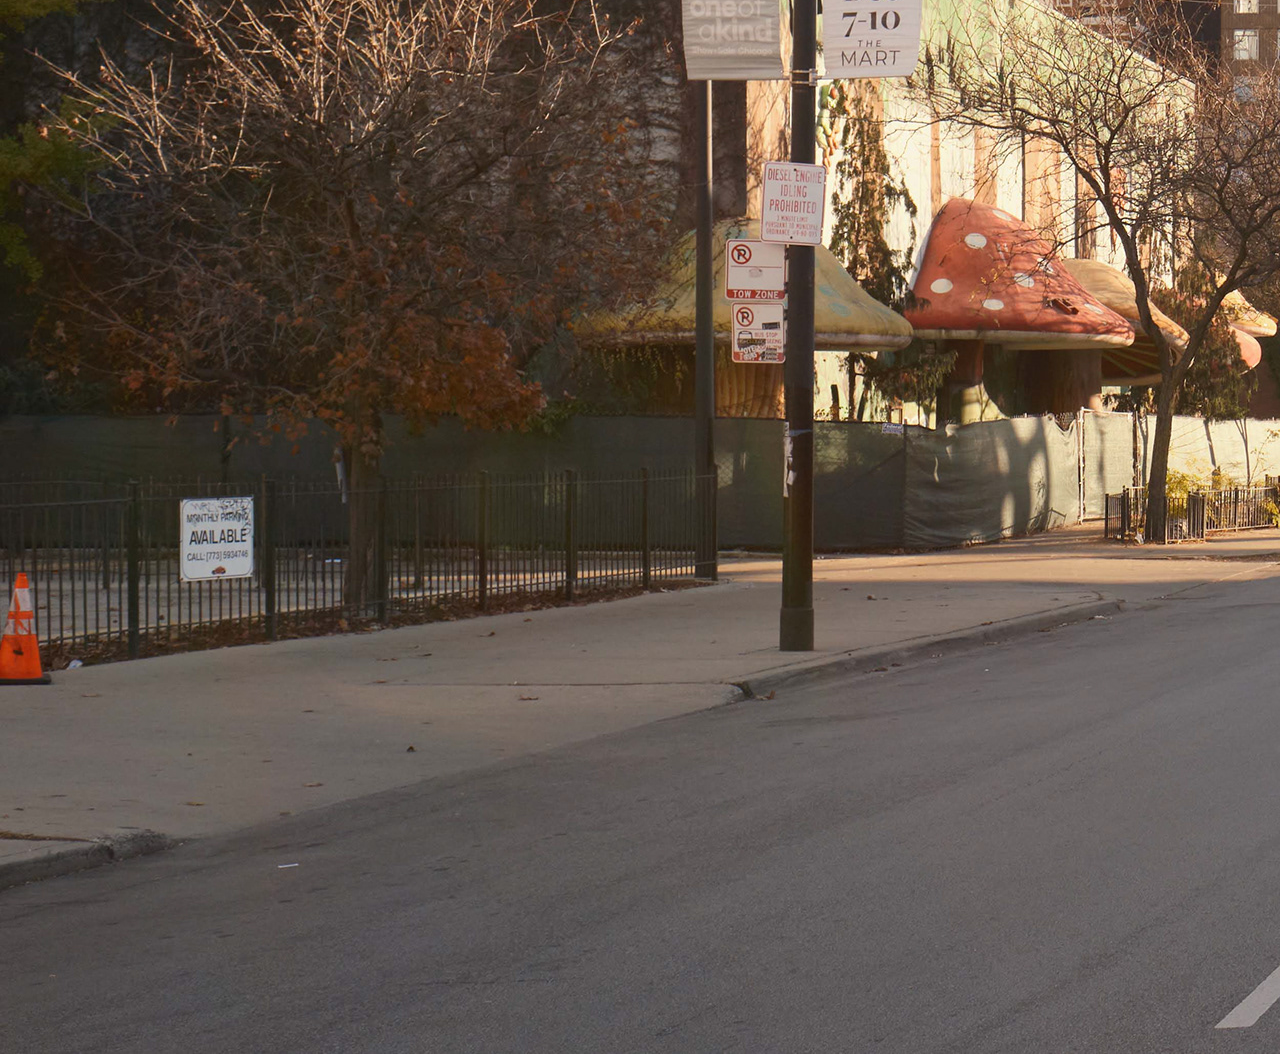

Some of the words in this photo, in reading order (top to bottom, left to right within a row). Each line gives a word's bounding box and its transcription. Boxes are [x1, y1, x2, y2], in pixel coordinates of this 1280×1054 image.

[842, 10, 901, 37] 7-10
[841, 50, 901, 66] MART
[768, 168, 792, 181] DIESEL
[796, 170, 822, 184] ENGINE
[781, 184, 807, 198] IDLING
[769, 199, 816, 214] PROHIBITED
[733, 290, 752, 298] TOW
[755, 290, 779, 298] ZONE
[187, 513, 219, 522] MONTHLY
[189, 529, 247, 545] AVAILABLE
